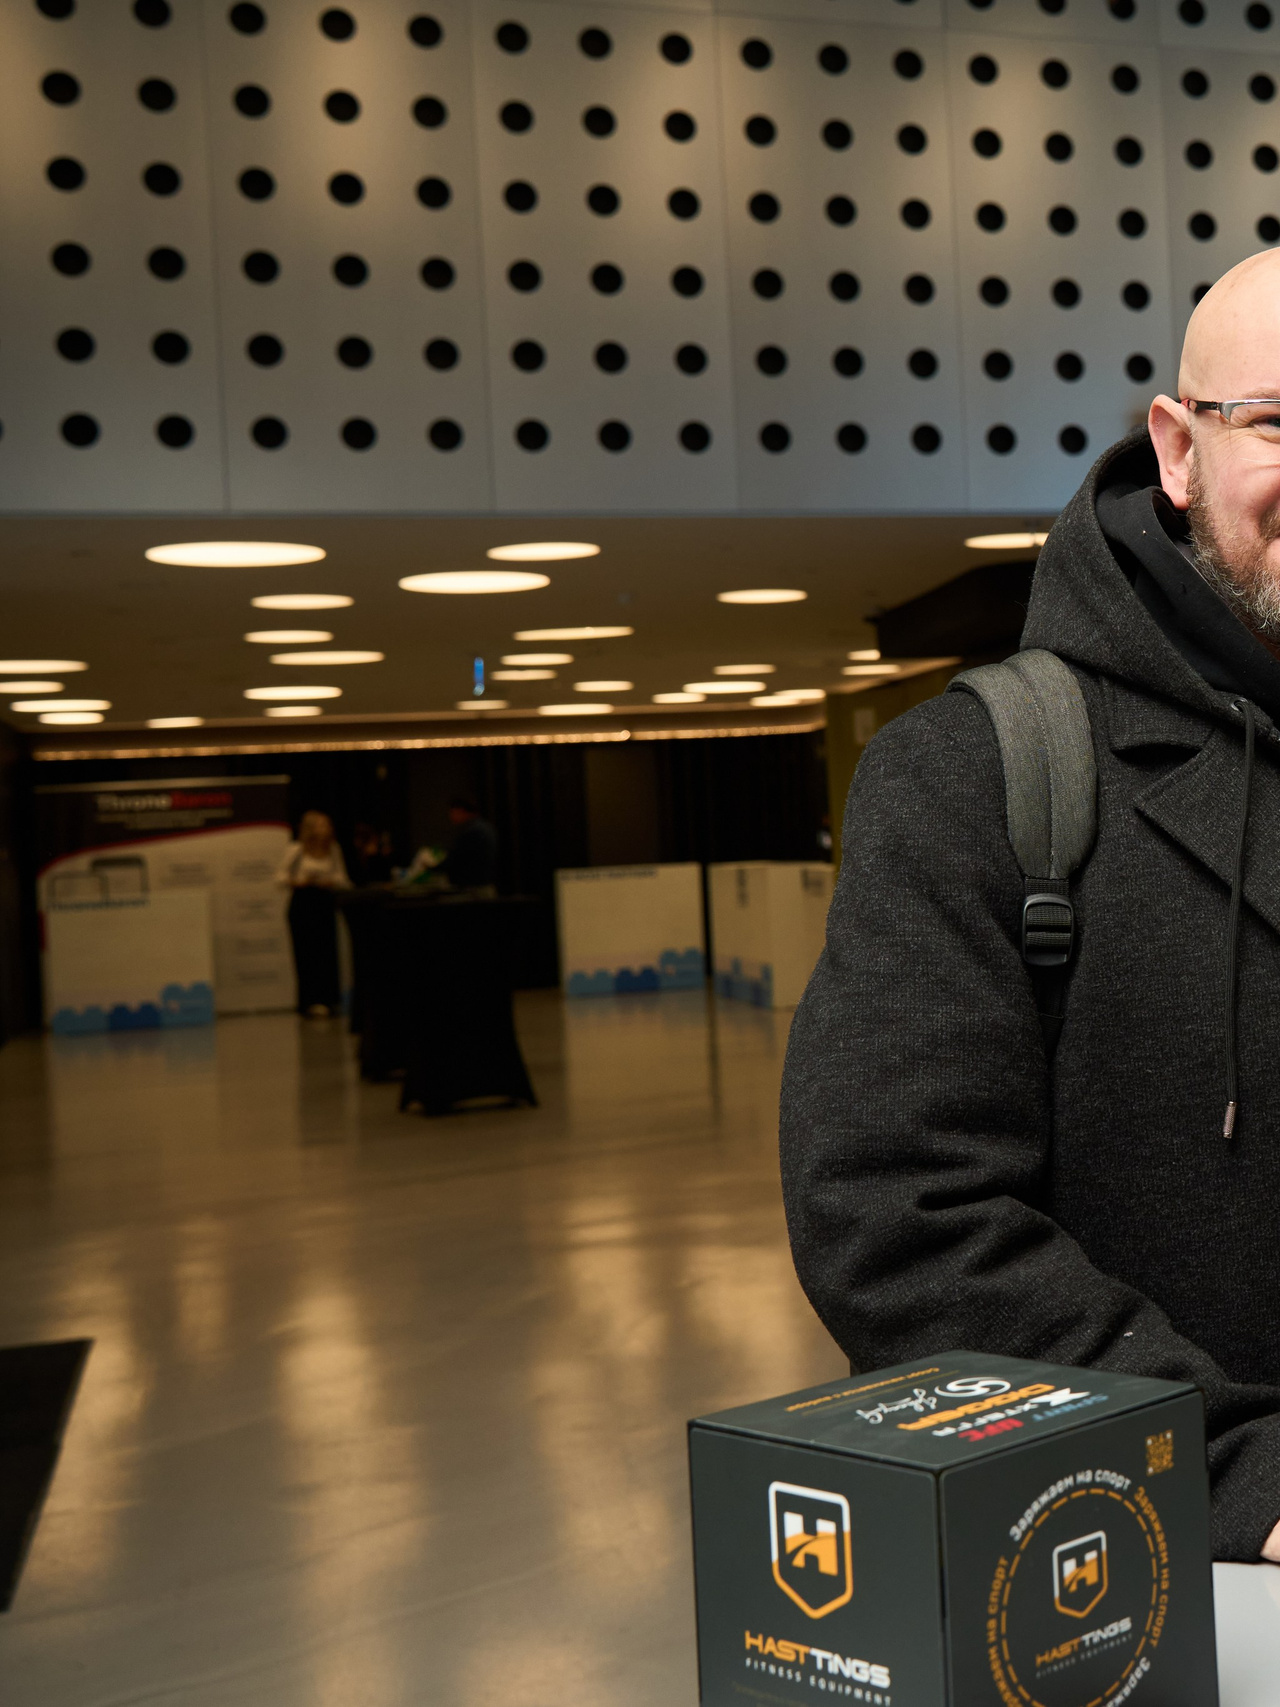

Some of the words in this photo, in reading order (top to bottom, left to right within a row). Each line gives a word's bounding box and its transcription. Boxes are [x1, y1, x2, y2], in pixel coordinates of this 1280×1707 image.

[1009, 1473, 1074, 1542] Заряжаем
[1075, 1469, 1093, 1484] на
[1095, 1469, 1132, 1491] спорт
[1160, 1567, 1170, 1590] на
[1150, 1593, 1169, 1648] спорт
[744, 1630, 891, 1689] HASTTINGS
[745, 1657, 802, 1683] FITNESS
[809, 1675, 892, 1707] EQUIPMENT
[1105, 1656, 1151, 1707] Заряж
